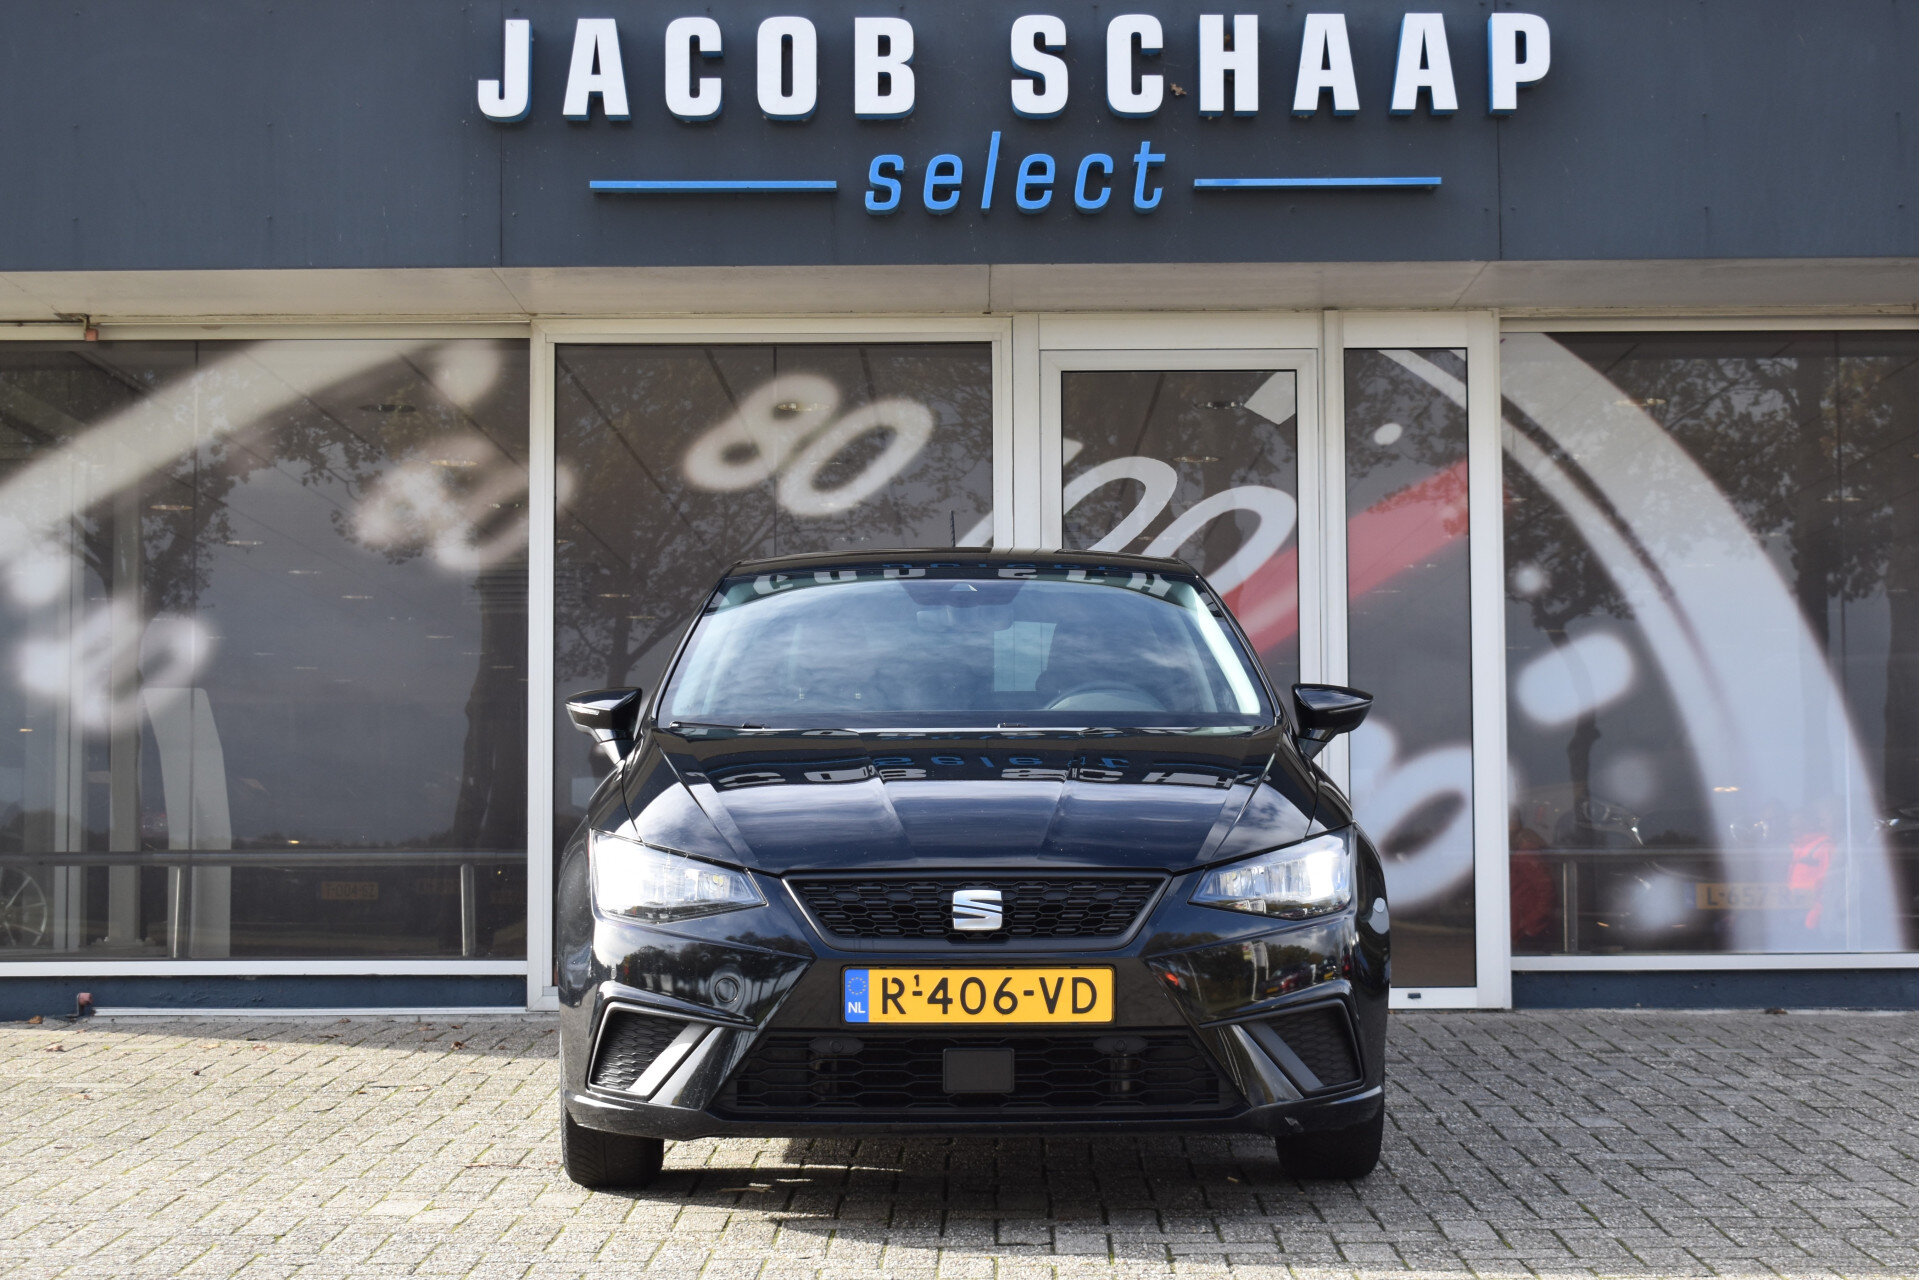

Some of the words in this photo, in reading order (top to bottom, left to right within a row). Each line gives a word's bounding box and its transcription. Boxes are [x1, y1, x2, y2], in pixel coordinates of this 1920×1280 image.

[477, 16, 916, 122] JACOB
[1010, 12, 1551, 119] SCHAAP
[865, 131, 1166, 214] select
[684, 373, 936, 517] 80
[848, 1002, 866, 1014] NL
